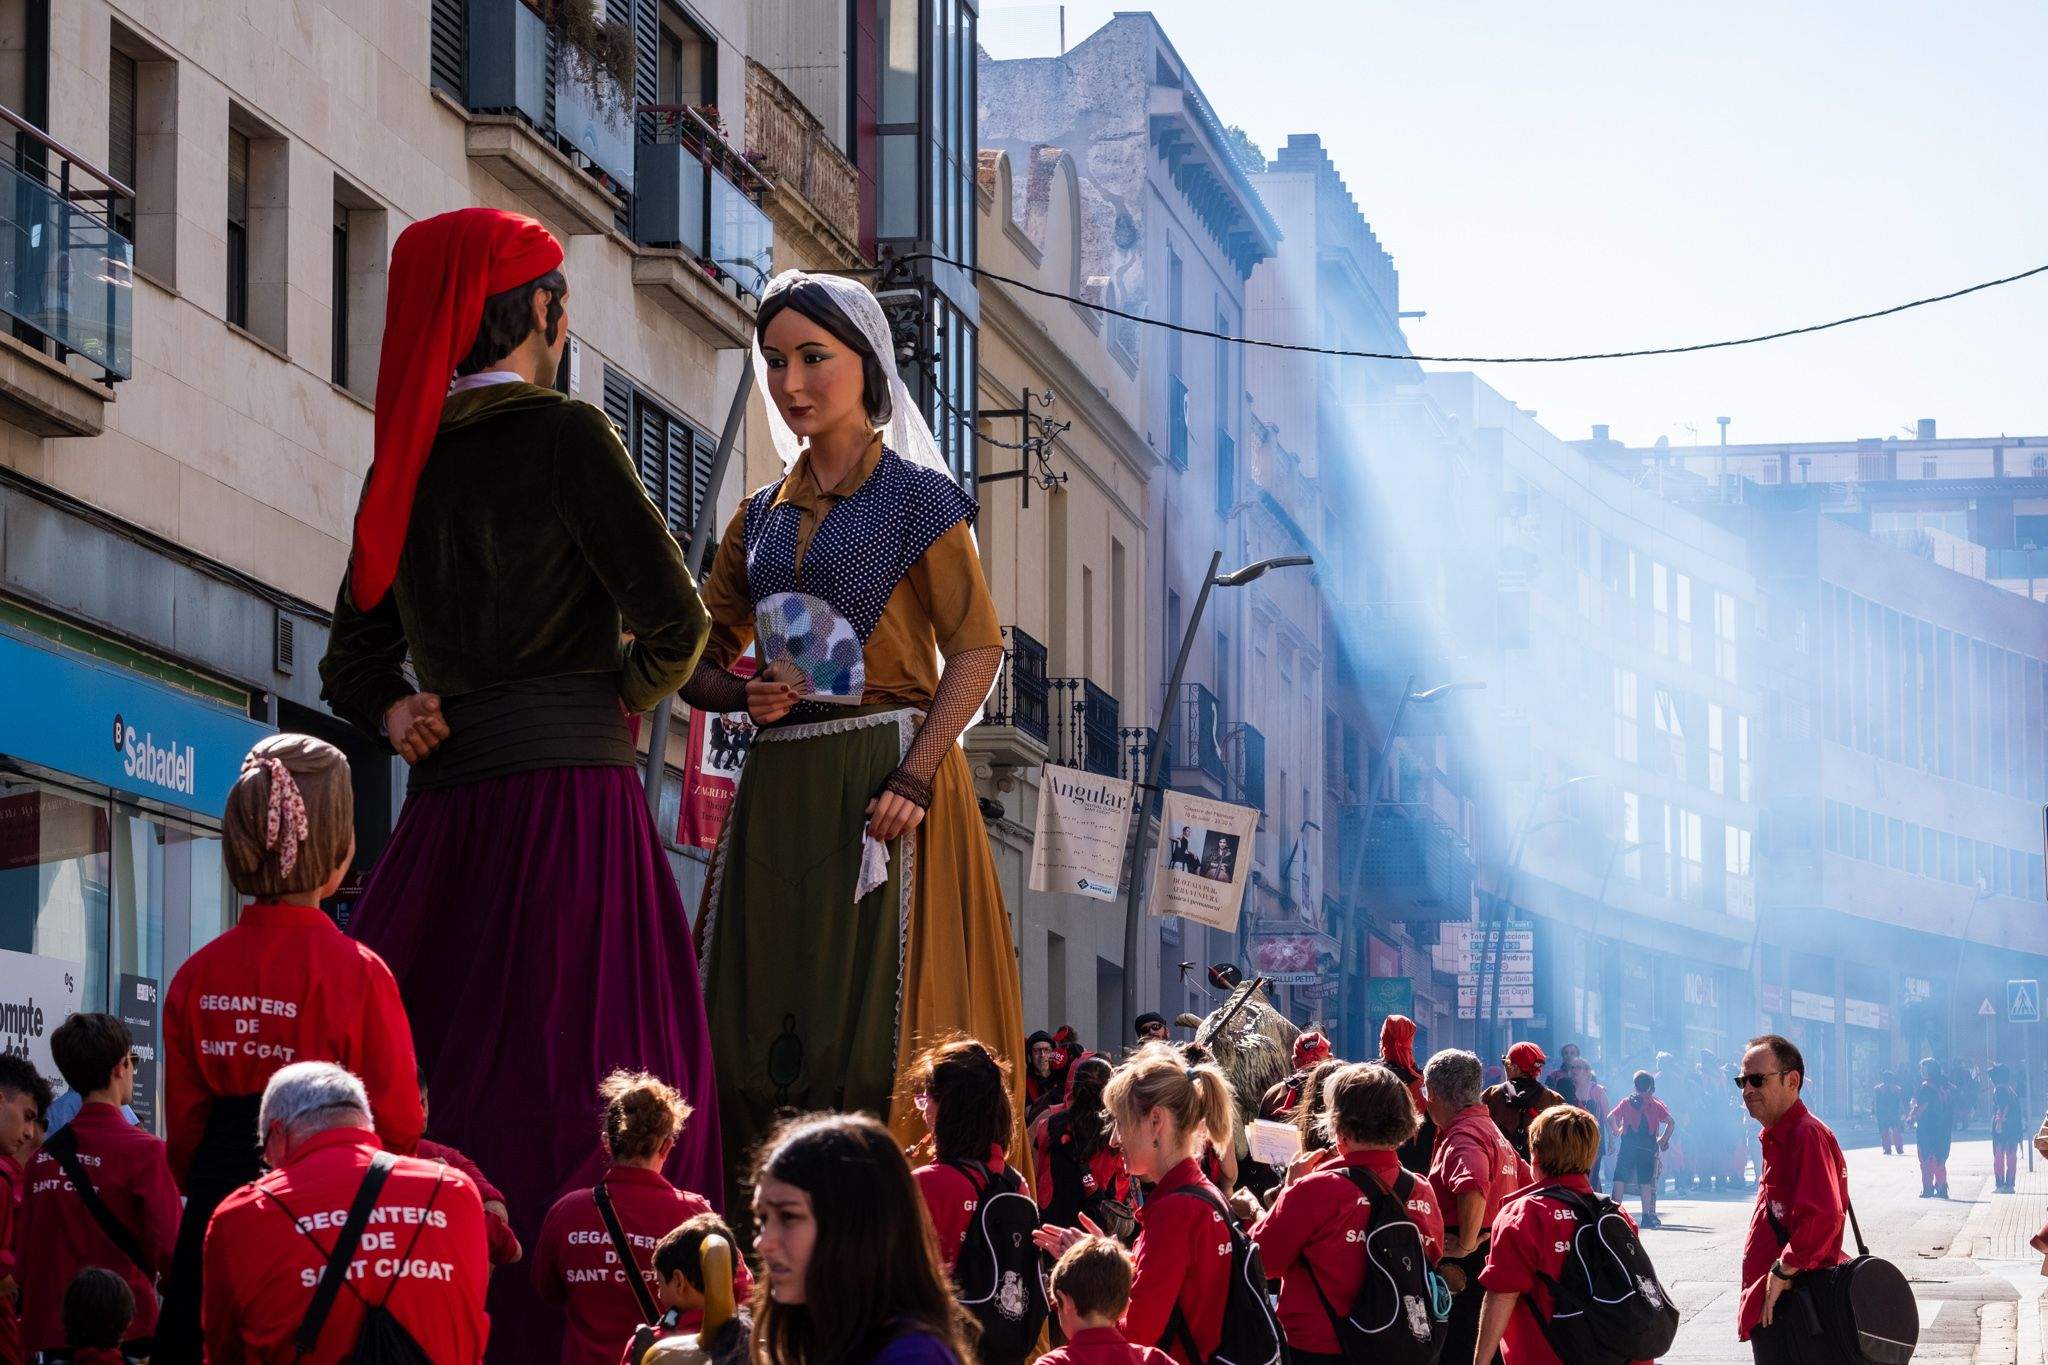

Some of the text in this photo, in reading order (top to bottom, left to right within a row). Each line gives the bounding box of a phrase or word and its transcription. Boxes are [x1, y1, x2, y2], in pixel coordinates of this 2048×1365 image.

[124, 726, 194, 795] Sabadell
[1493, 932, 1530, 940] Deccions
[235, 1018, 260, 1034] DE
[201, 1040, 238, 1056] SANT
[295, 1206, 448, 1234] GEGNTERS
[361, 1231, 396, 1251] DE
[568, 1231, 659, 1249] GEGATER
[374, 1258, 454, 1282] CUGAT
[566, 1269, 609, 1282] SANT
